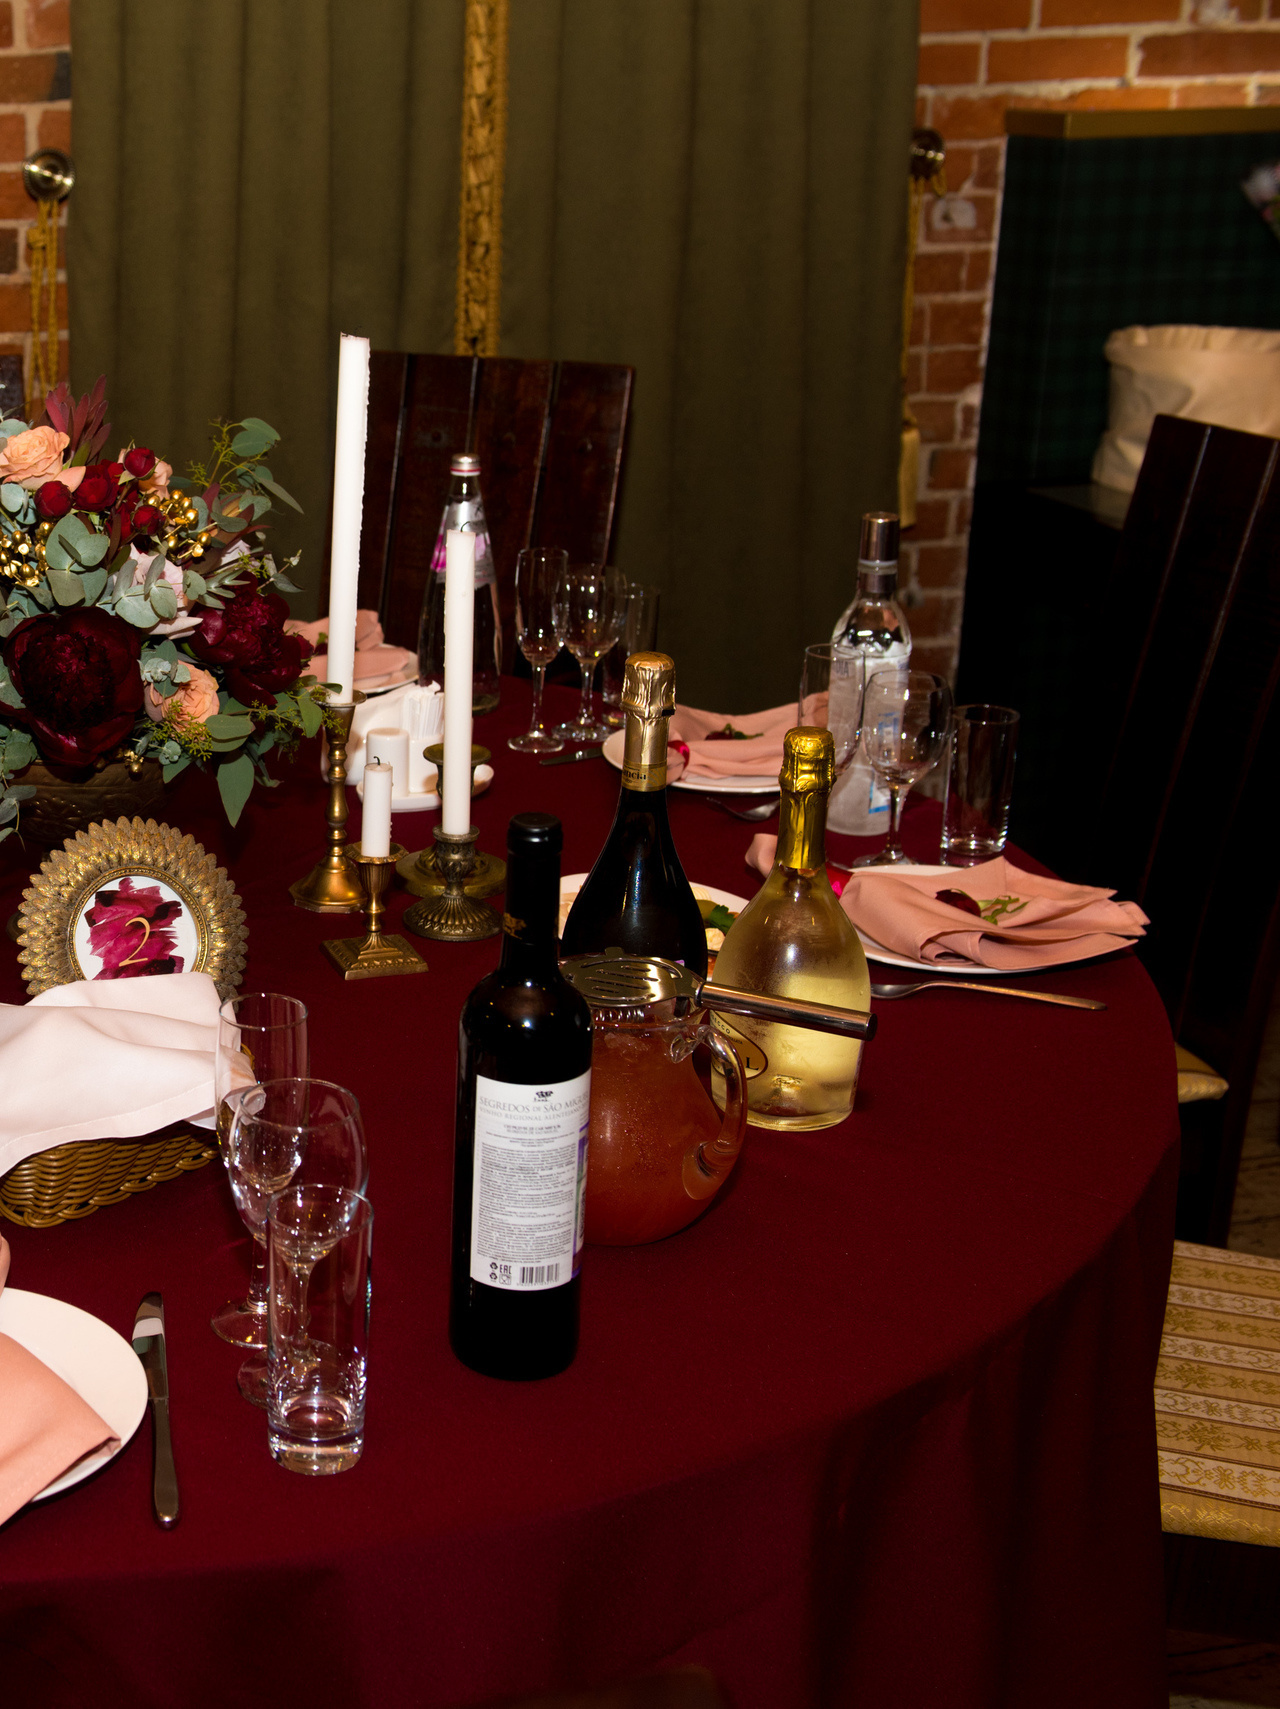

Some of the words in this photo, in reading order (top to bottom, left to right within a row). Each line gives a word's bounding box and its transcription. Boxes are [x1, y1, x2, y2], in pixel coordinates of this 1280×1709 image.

[118, 916, 151, 967] 2
[479, 1096, 530, 1114] SEGREDOS
[543, 1102, 563, 1114] SÃO
[504, 1112, 542, 1122] REGIONAL
